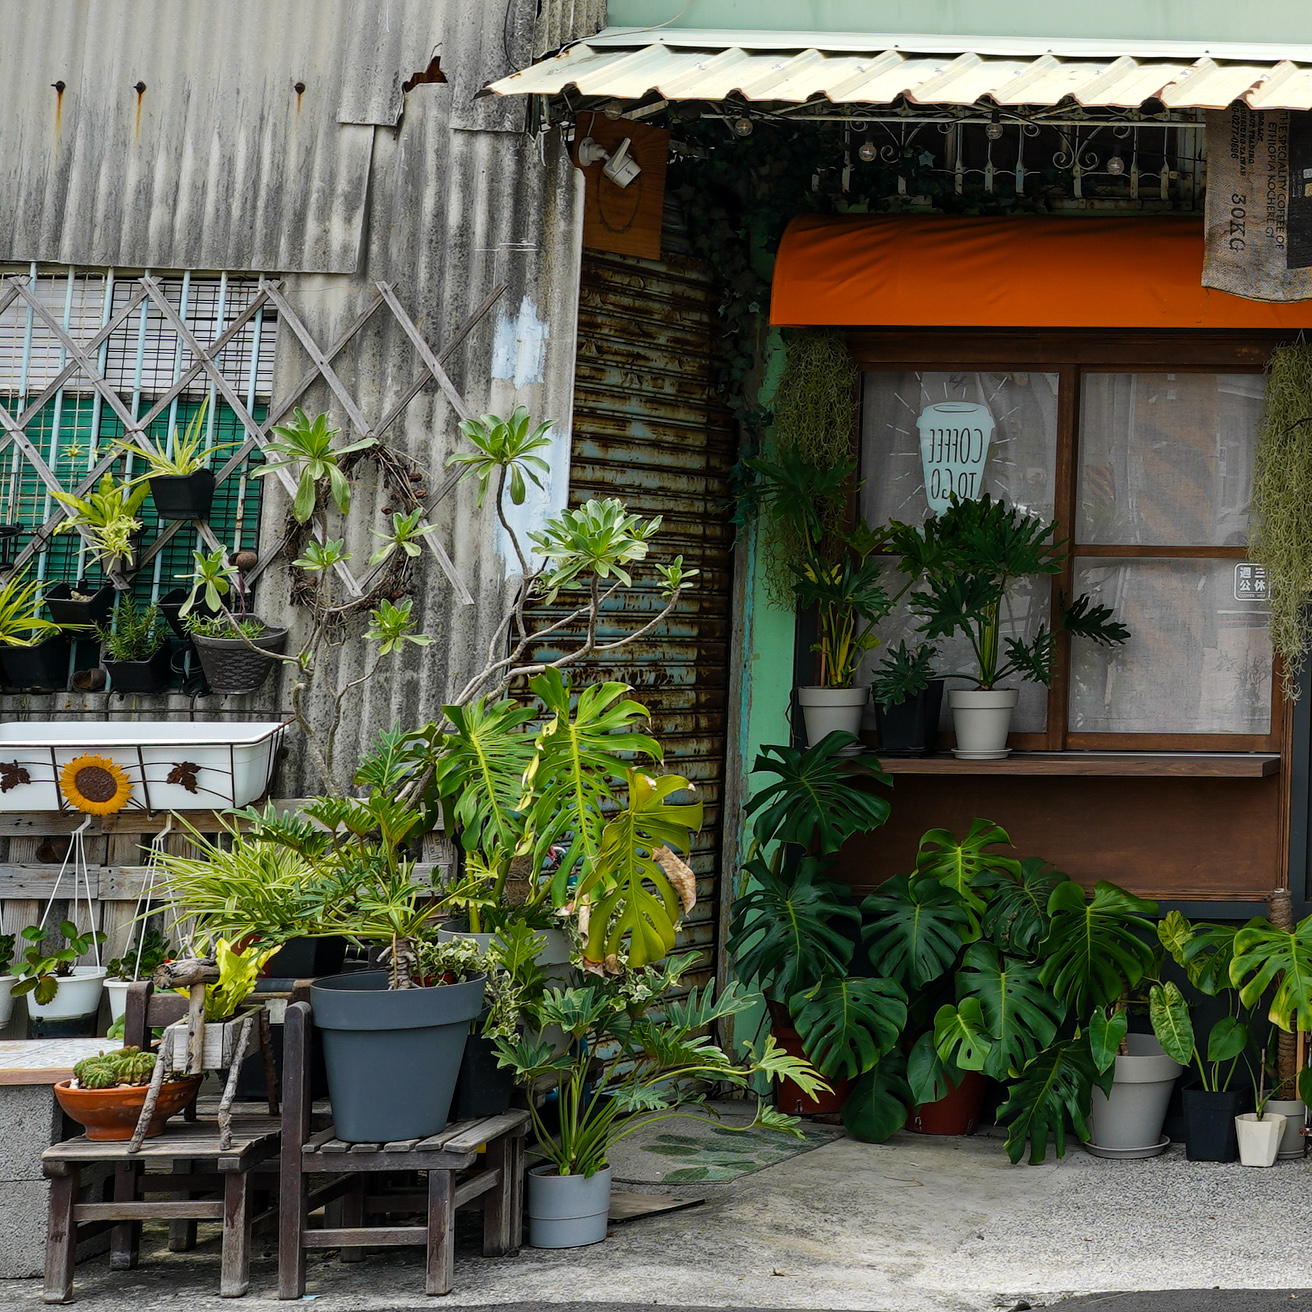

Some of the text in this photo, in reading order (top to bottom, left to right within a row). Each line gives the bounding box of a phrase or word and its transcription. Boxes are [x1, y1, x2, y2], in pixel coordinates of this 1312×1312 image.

[1267, 122, 1277, 172] ETHIOPIA
[1277, 134, 1288, 191] SPECIALITY
[1229, 193, 1247, 253] 30KG
[1276, 193, 1286, 233] COFFEE
[1276, 236, 1285, 249] OF
